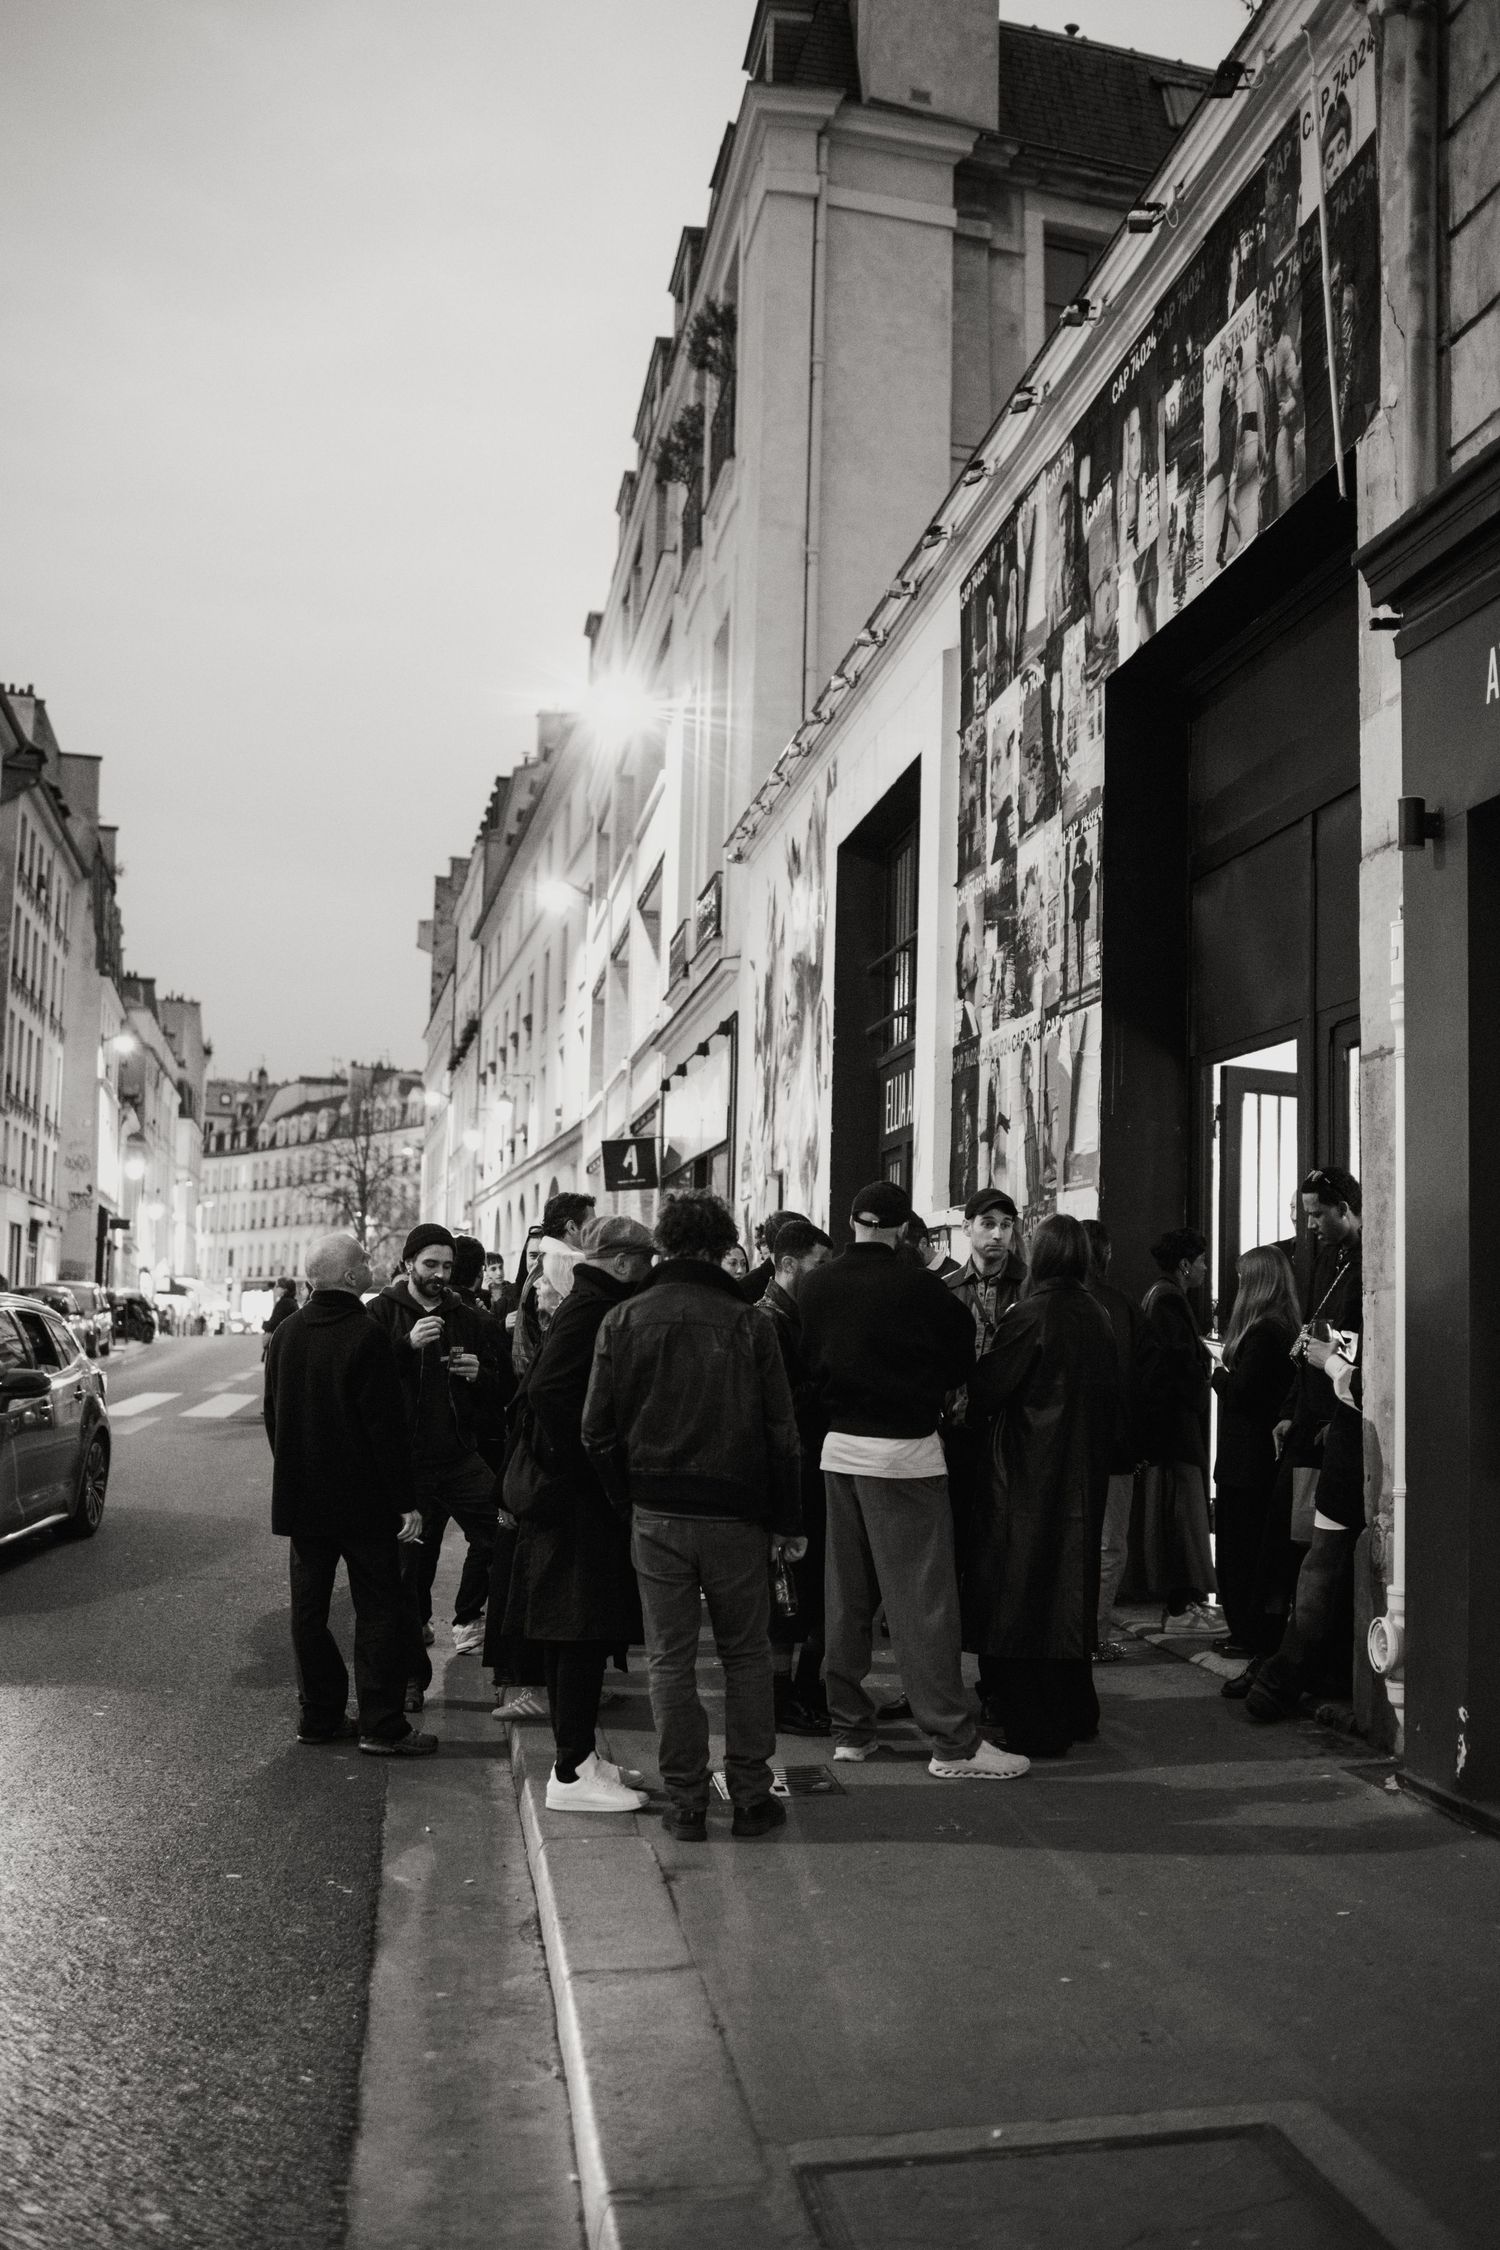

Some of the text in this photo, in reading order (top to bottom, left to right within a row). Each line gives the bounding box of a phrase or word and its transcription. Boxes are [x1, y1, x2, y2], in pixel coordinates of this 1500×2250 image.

[1302, 86, 1330, 141] CP
[1332, 31, 1375, 112] 74024
[1267, 140, 1292, 187] CAP
[1303, 225, 1322, 264] CA
[1258, 270, 1283, 315] CAP
[1112, 366, 1129, 404] CAP
[1130, 329, 1157, 380] 74024
[1205, 346, 1227, 385] CAP
[1046, 461, 1060, 494] CAP
[1063, 821, 1078, 845] CAP
[1011, 1030, 1025, 1052] CAP
